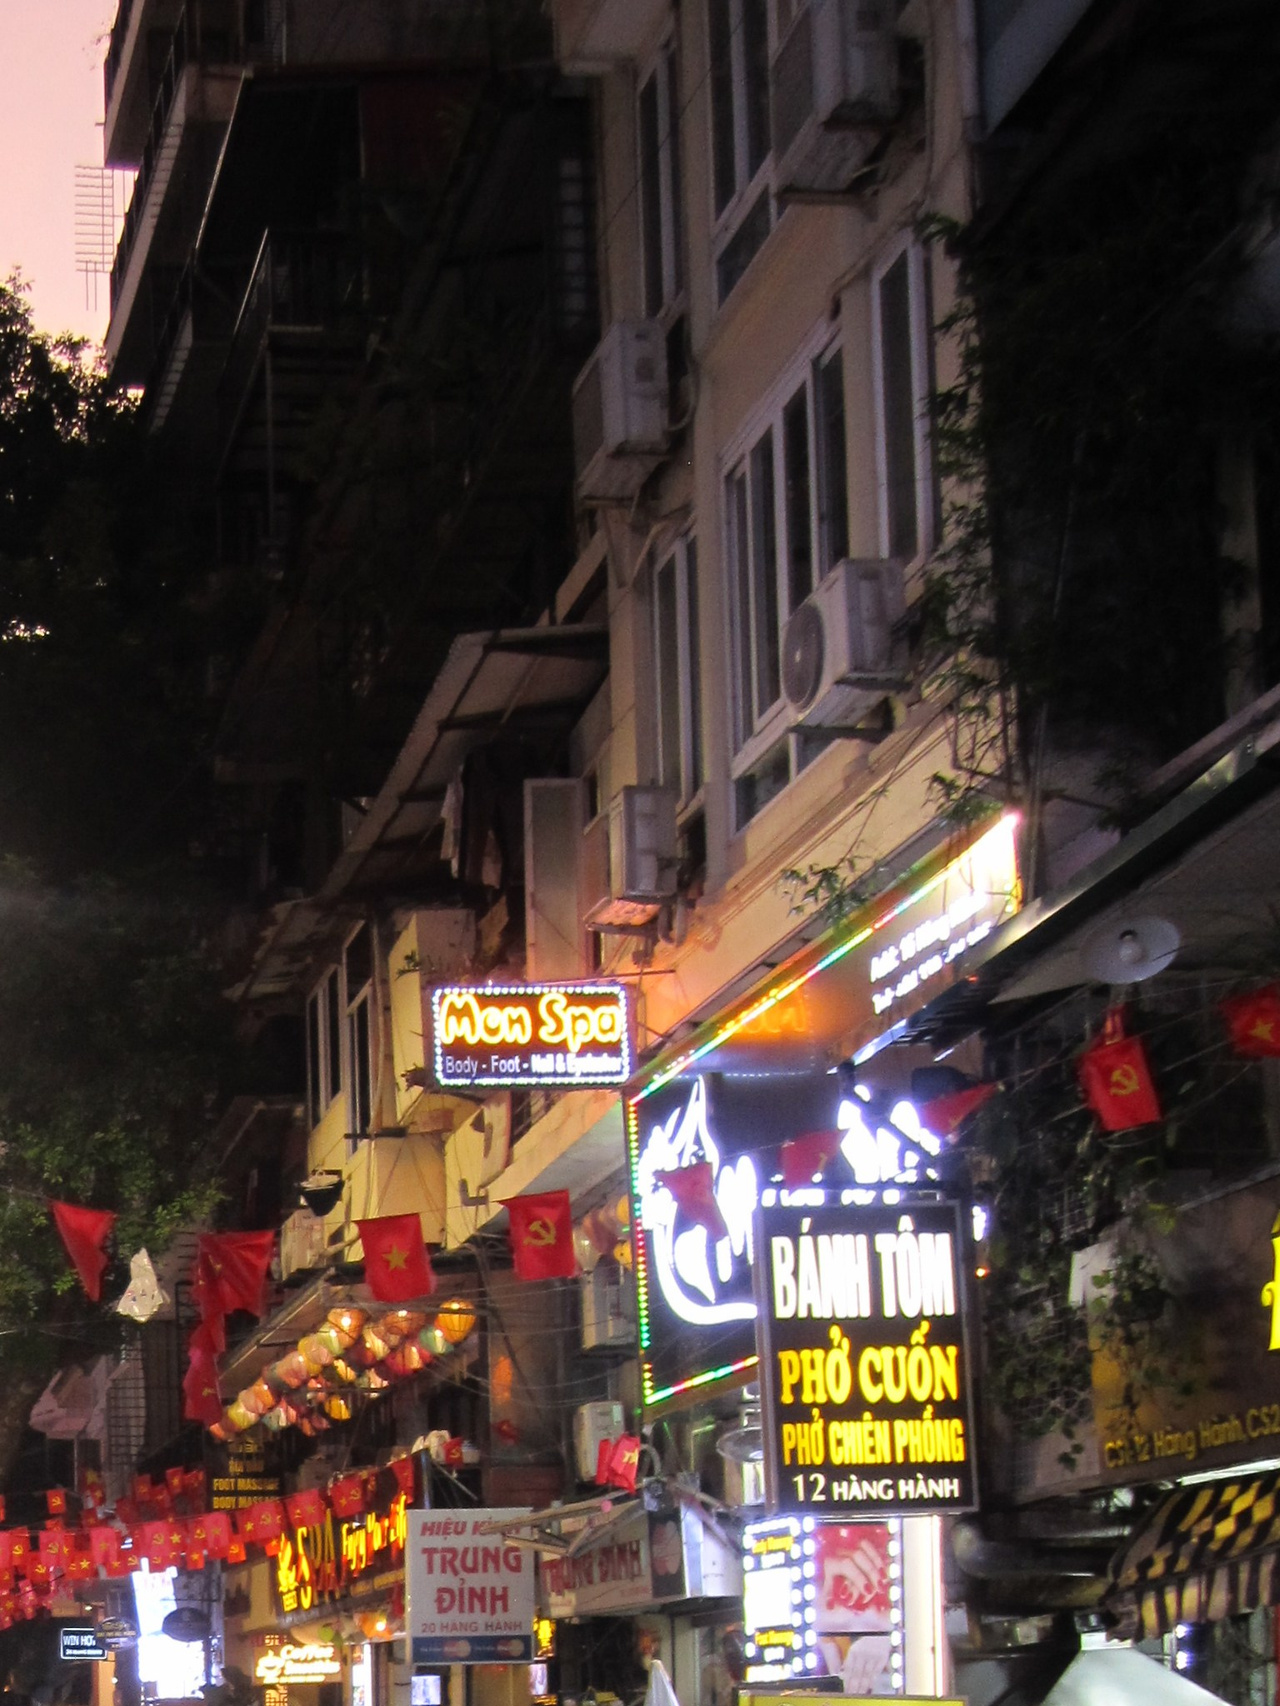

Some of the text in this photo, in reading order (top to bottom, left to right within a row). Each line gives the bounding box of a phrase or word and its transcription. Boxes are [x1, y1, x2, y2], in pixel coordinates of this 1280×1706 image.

[539, 993, 621, 1053] Spa
[445, 1055, 477, 1077] Body
[491, 1055, 520, 1073] Foot
[771, 1214, 956, 1319] BÁNH TÔM
[778, 1320, 959, 1404] PHỞ CUỐN
[782, 1407, 826, 1466] PHỞ
[828, 1411, 892, 1466] CHIÊN
[793, 1472, 959, 1502] 12 HÀNG HÀNH
[420, 1517, 467, 1540] HIỆU
[421, 1546, 523, 1577] TRUNG
[434, 1577, 510, 1617] ĐỈNH
[421, 1622, 436, 1633] 20
